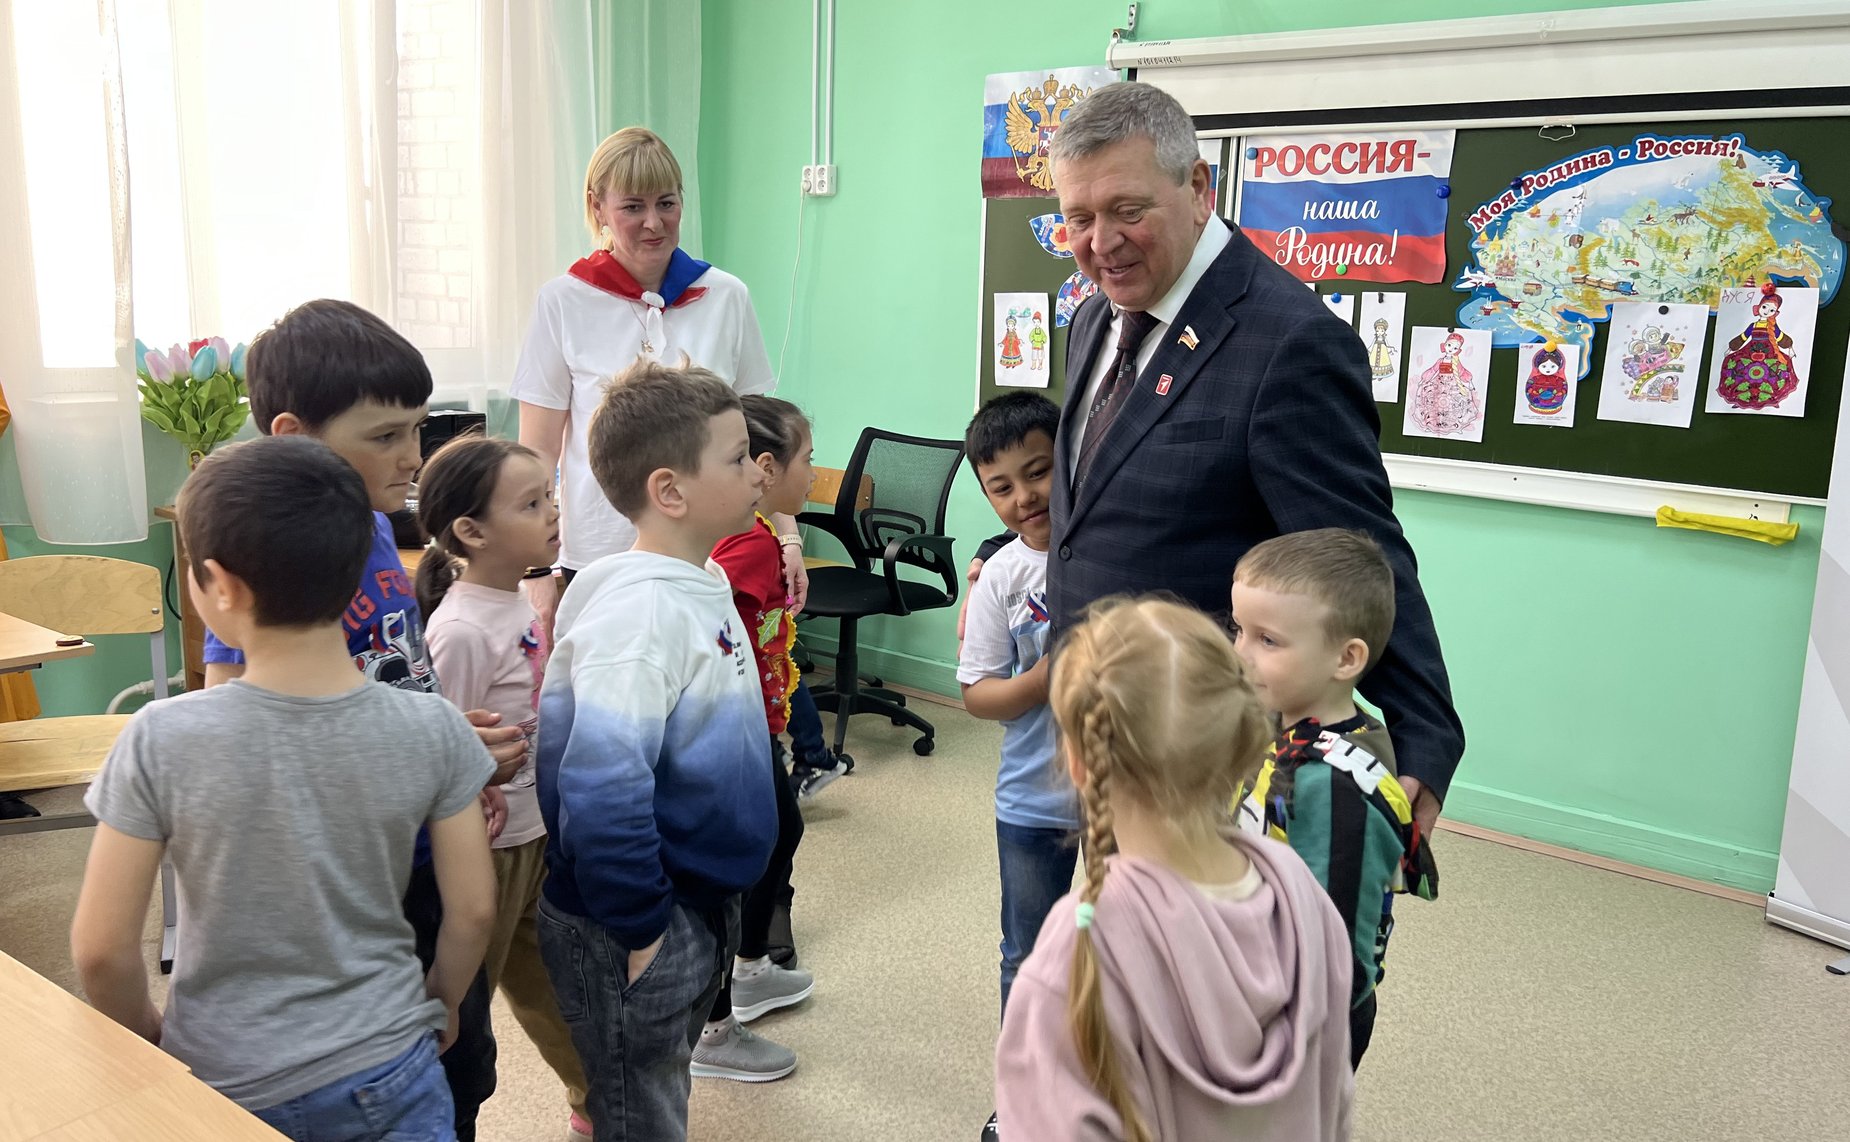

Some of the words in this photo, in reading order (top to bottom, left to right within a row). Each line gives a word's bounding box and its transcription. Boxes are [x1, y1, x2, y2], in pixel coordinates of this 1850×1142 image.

[1254, 139, 1431, 178] РОССИЯ-
[1469, 192, 1516, 231] Моя
[1521, 150, 1611, 195] Родина
[1637, 139, 1739, 158] Россия!
[1302, 199, 1381, 221] наша
[1275, 226, 1398, 279] Родина!
[343, 587, 377, 640] IG
